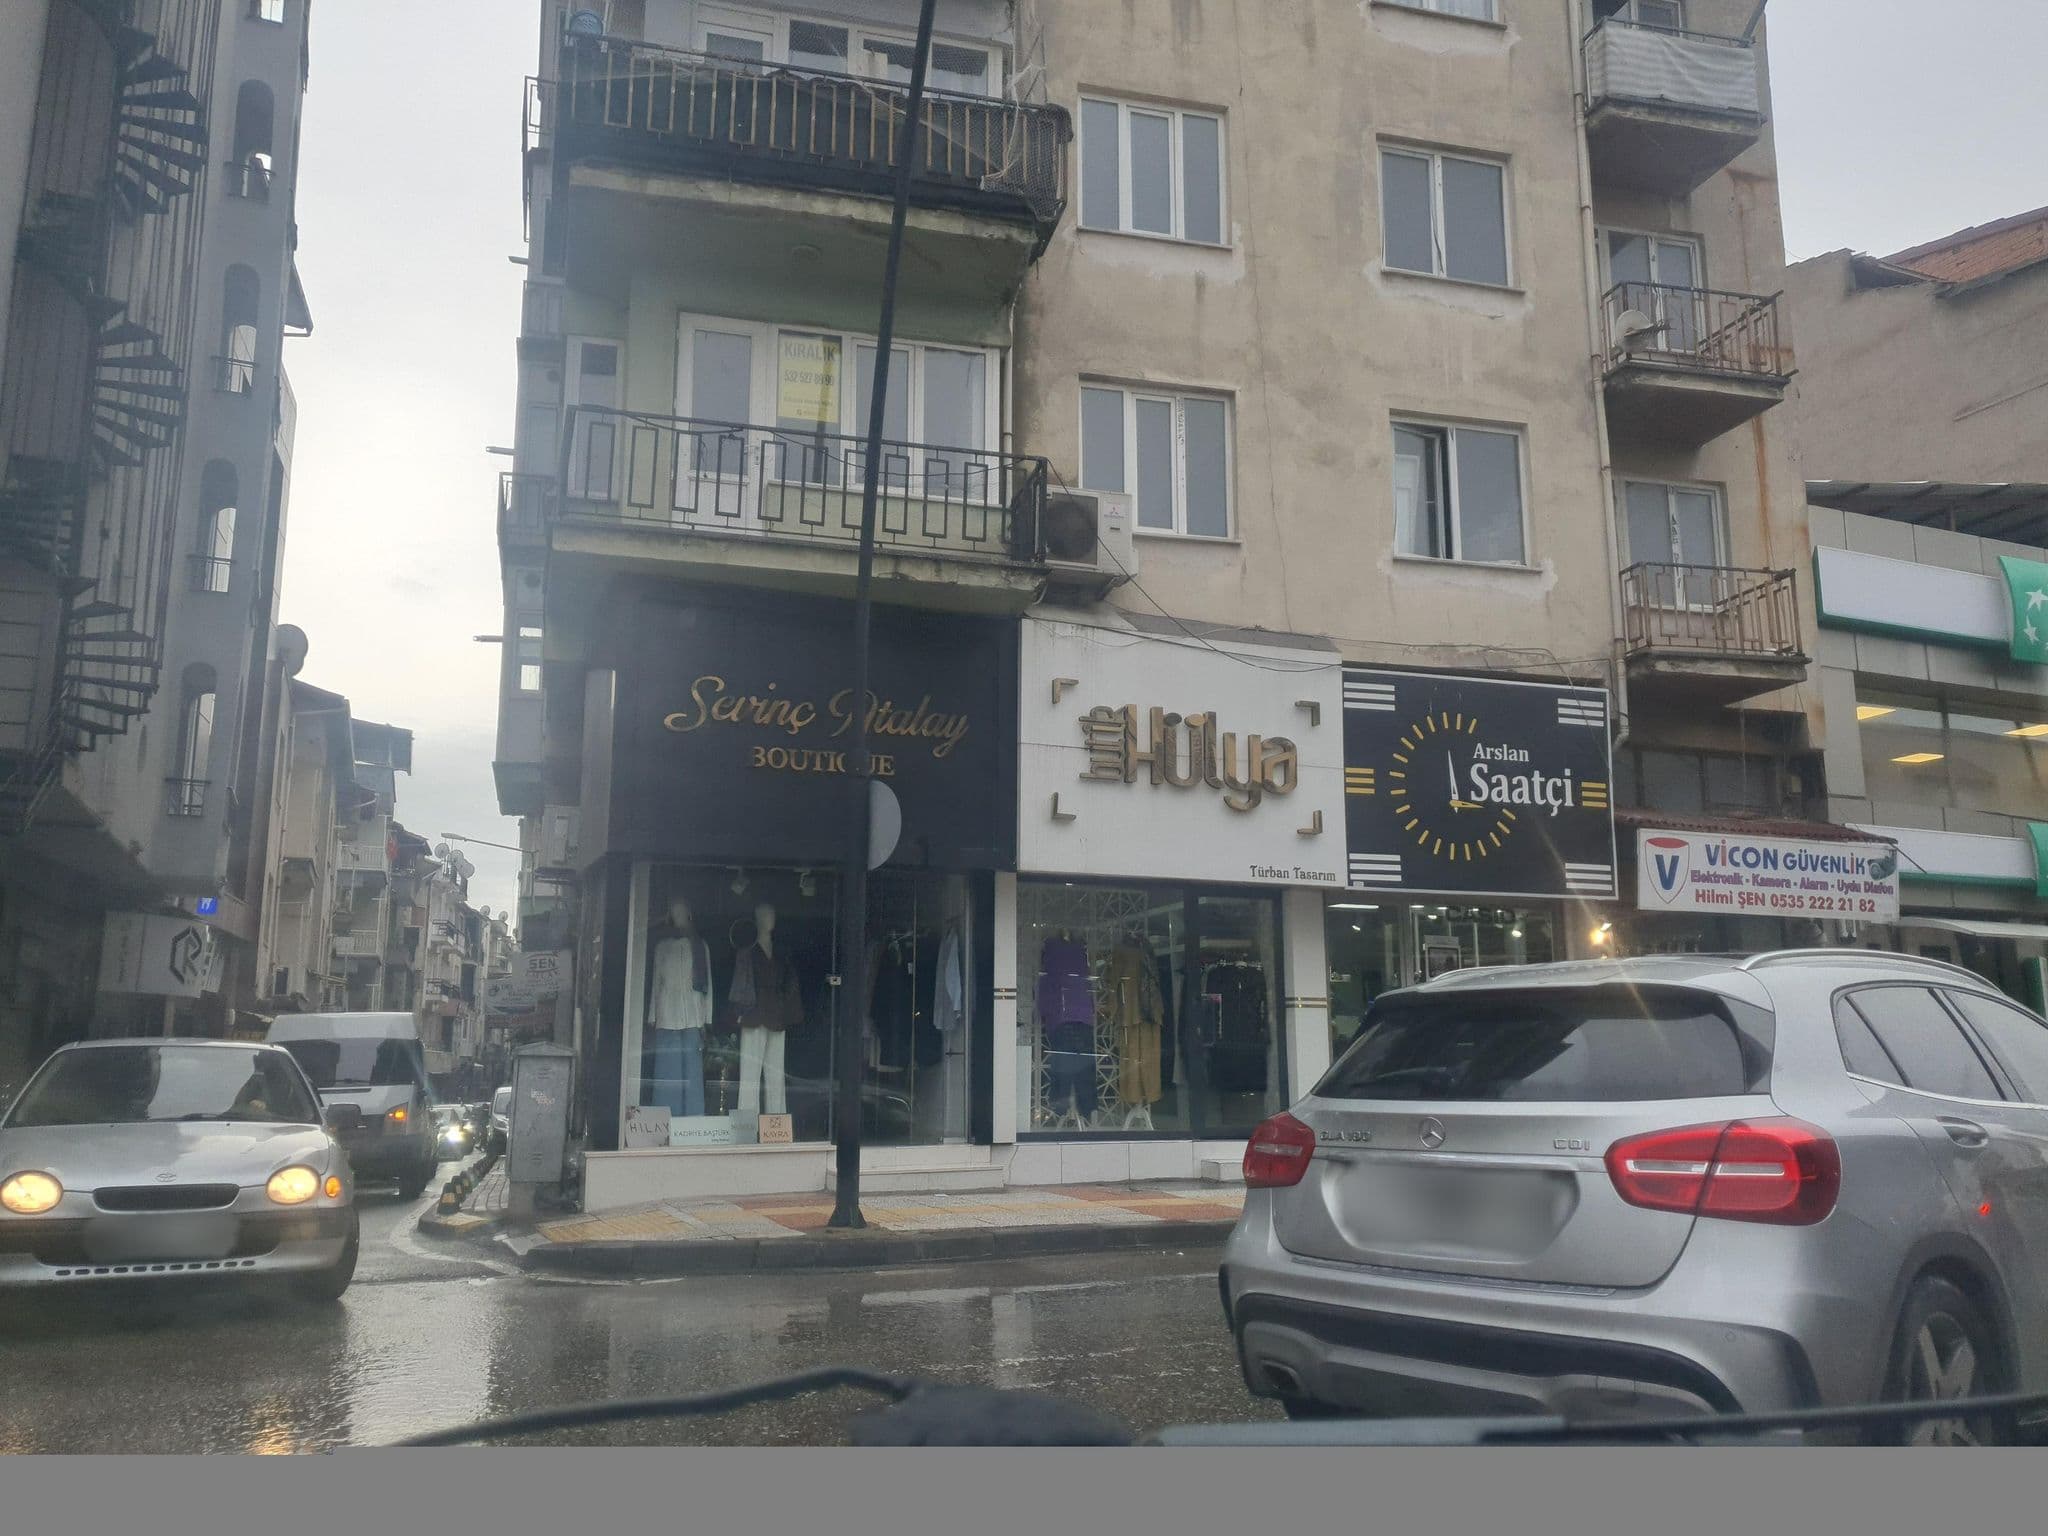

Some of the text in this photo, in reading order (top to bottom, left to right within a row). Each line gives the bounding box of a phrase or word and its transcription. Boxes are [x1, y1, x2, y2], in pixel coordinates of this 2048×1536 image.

[784, 341, 835, 361] KIRALIK
[1123, 704, 1298, 811] Hülya
[1473, 743, 1530, 762] Arslan
[1470, 763, 1574, 817] Saatçi
[1783, 849, 1865, 875] GÜVENLİK
[1250, 865, 1336, 882] Türban Tasarım
[1690, 870, 1744, 886] Elektronik
[1752, 873, 1791, 889] Kamera
[1800, 877, 1829, 891] Alarm
[1695, 889, 1875, 912] Hilmi ŞEN 0535 222 21 82
[1552, 1137, 1591, 1151] CDI
